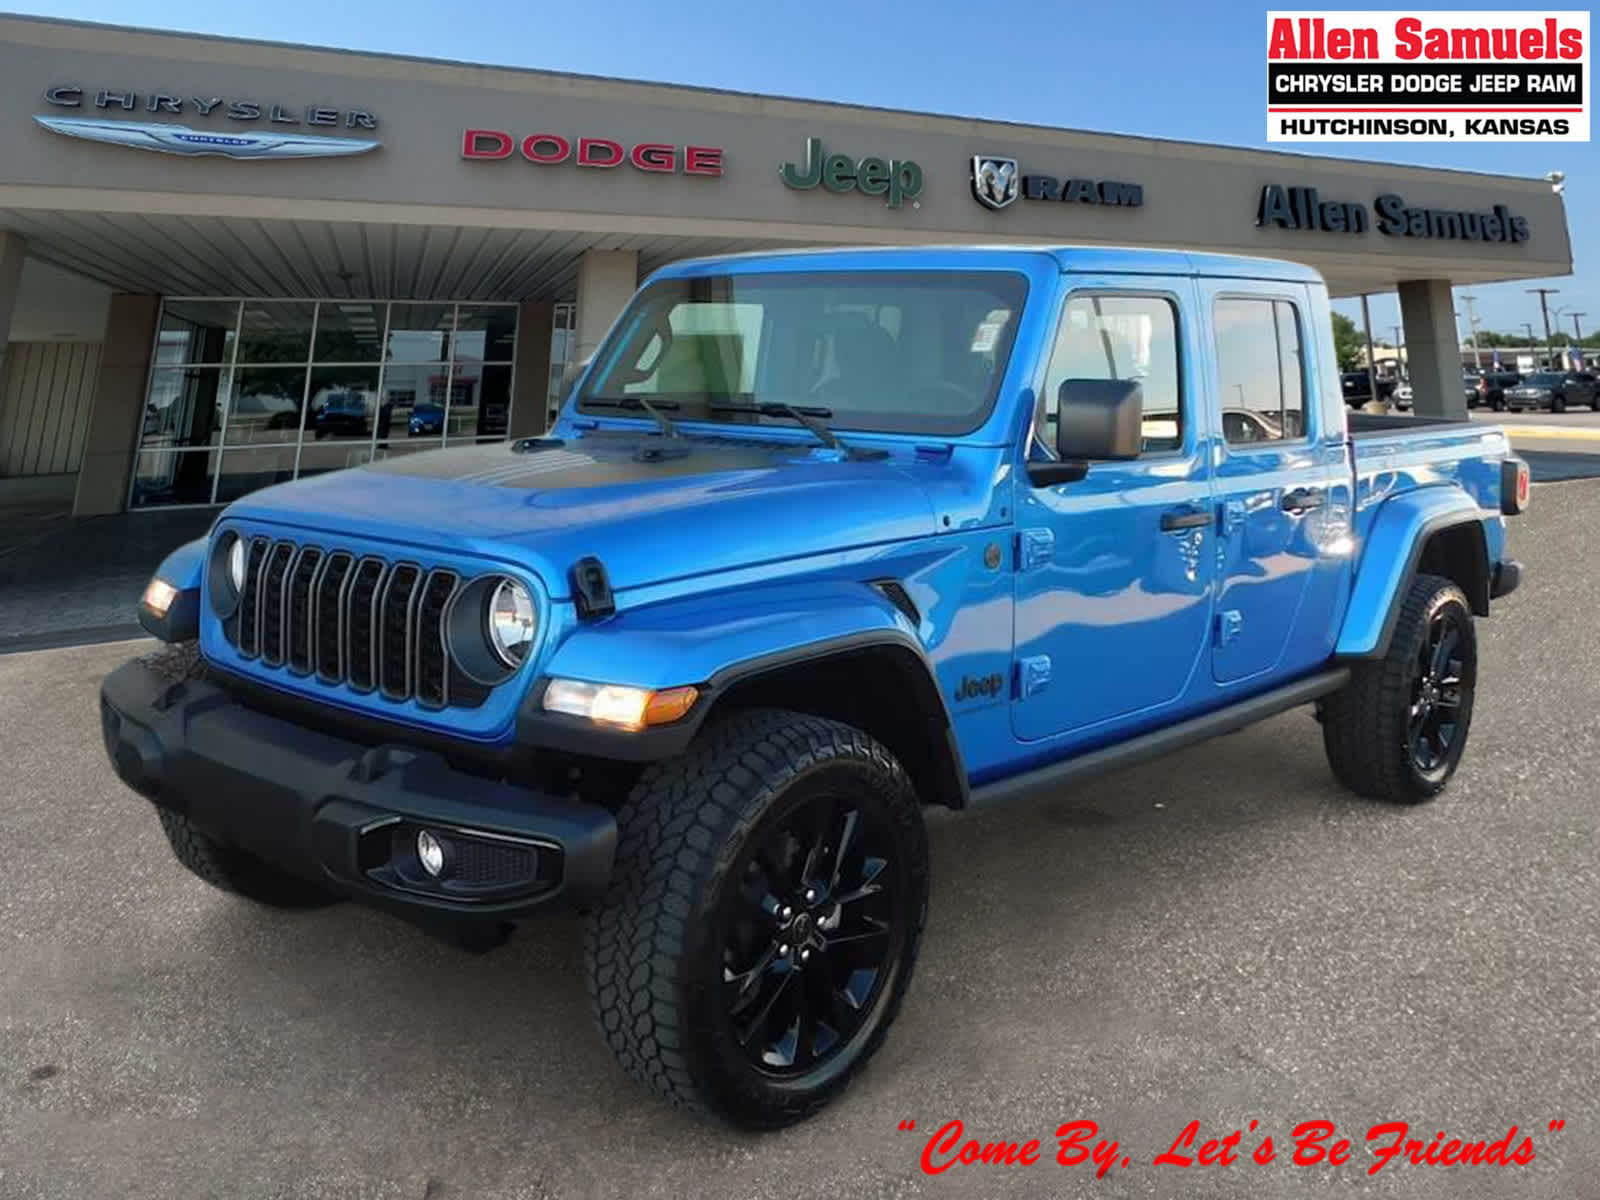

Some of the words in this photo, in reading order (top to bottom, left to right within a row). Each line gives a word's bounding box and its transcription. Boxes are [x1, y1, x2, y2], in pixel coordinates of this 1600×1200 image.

[43, 86, 378, 130] CHRYSLER
[461, 128, 724, 176] DODGE
[780, 137, 923, 208] Jeep
[1023, 174, 1144, 207] RAM
[1256, 184, 1369, 234] Allen
[1374, 194, 1530, 243] Samuels
[954, 673, 1004, 702] Jeep
